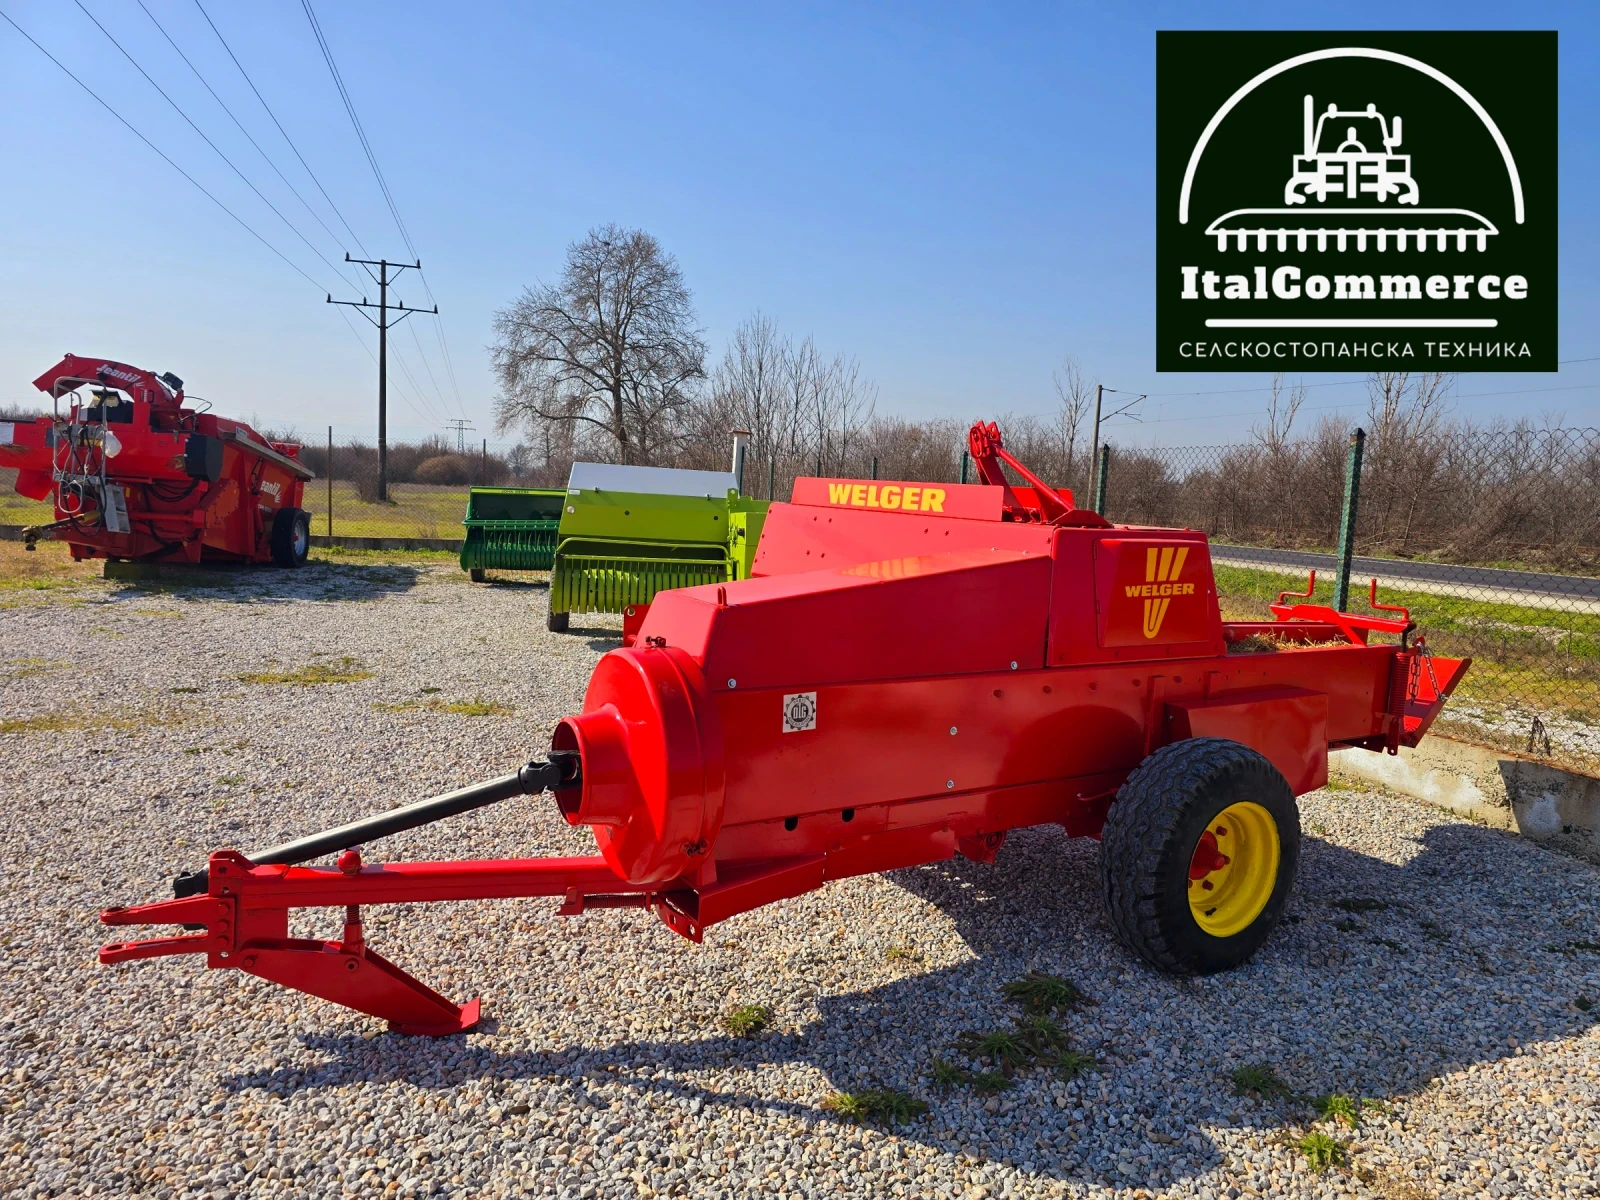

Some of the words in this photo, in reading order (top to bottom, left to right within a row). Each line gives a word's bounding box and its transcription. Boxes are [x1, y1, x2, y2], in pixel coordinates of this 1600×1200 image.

[96, 363, 142, 383] Jeantil
[828, 483, 946, 513] WELGER
[1125, 583, 1195, 597] WELGER
